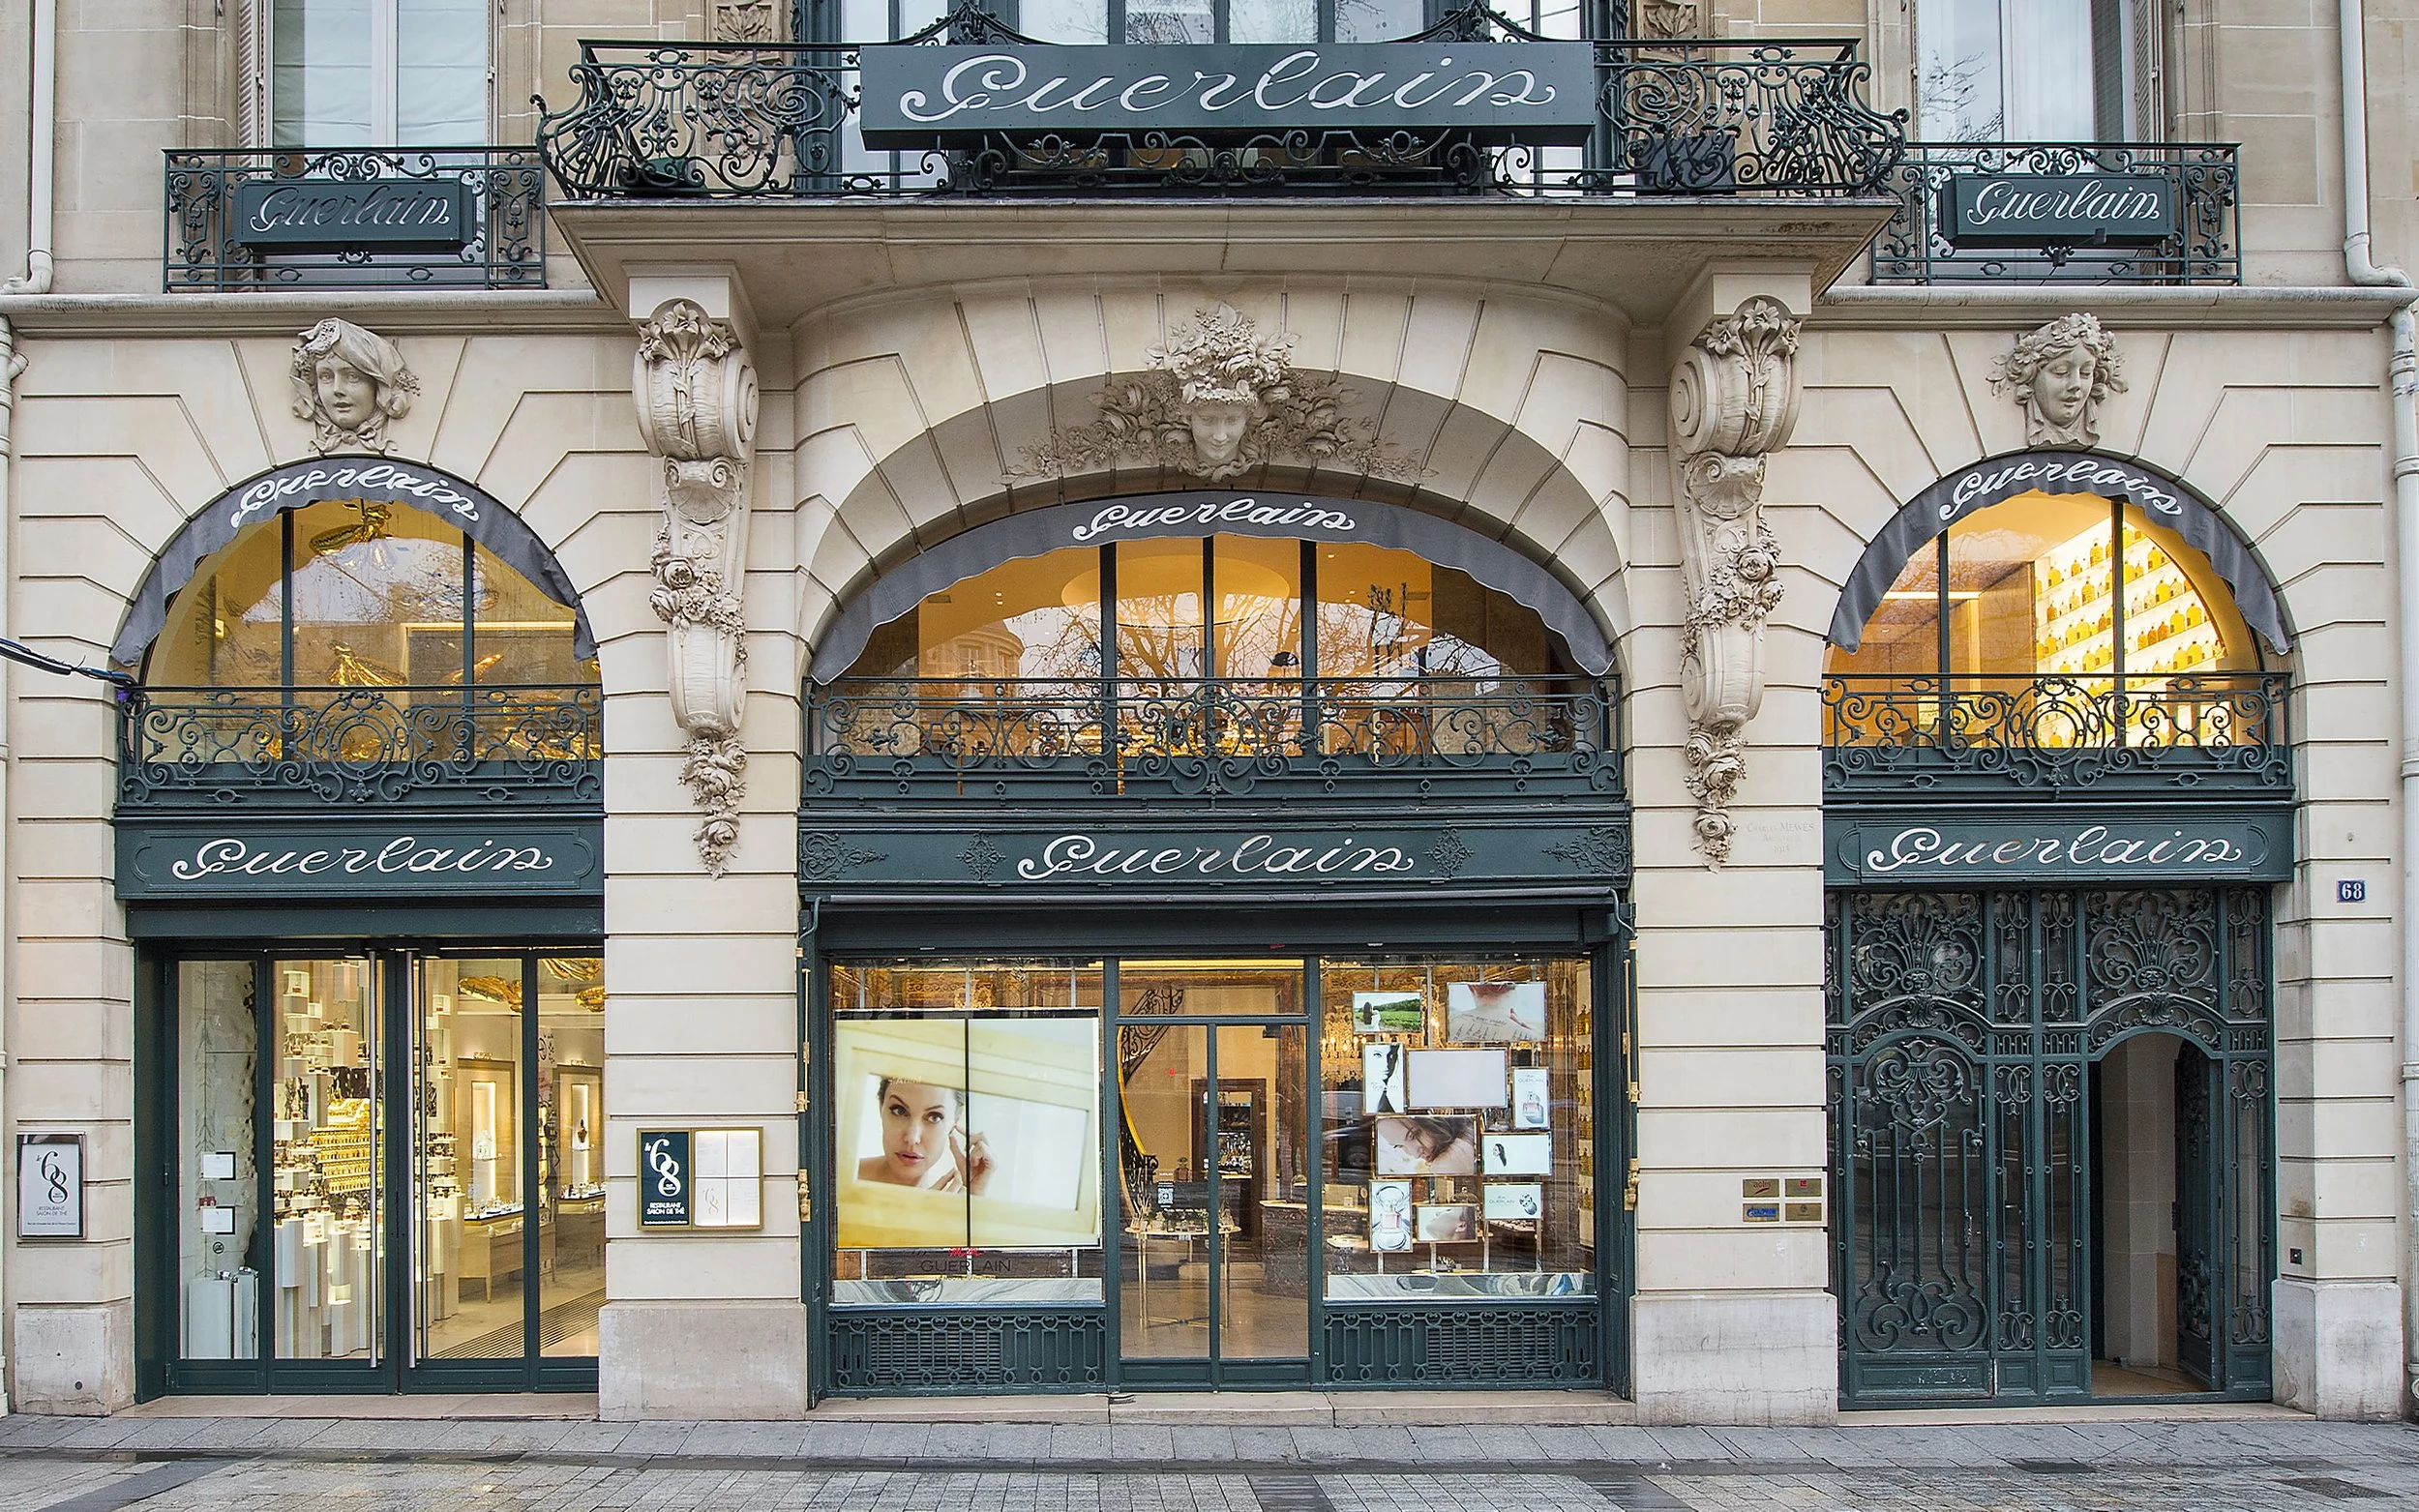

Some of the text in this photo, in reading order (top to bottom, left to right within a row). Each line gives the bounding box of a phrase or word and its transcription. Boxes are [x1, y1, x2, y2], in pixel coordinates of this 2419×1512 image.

[899, 48, 1557, 122] Guerlain
[250, 186, 450, 233] Guerlain
[1966, 180, 2161, 225] Guerlain
[230, 464, 480, 529] Guerlain
[1938, 460, 2184, 521] Guerlain
[1072, 497, 1356, 541] Guerlain
[171, 836, 553, 879] Guerlain
[1017, 834, 1415, 879] Guerlain
[1866, 825, 2244, 872] Guerlain
[2342, 882, 2363, 900] 68
[920, 1260, 1011, 1273] GUERLAIN
